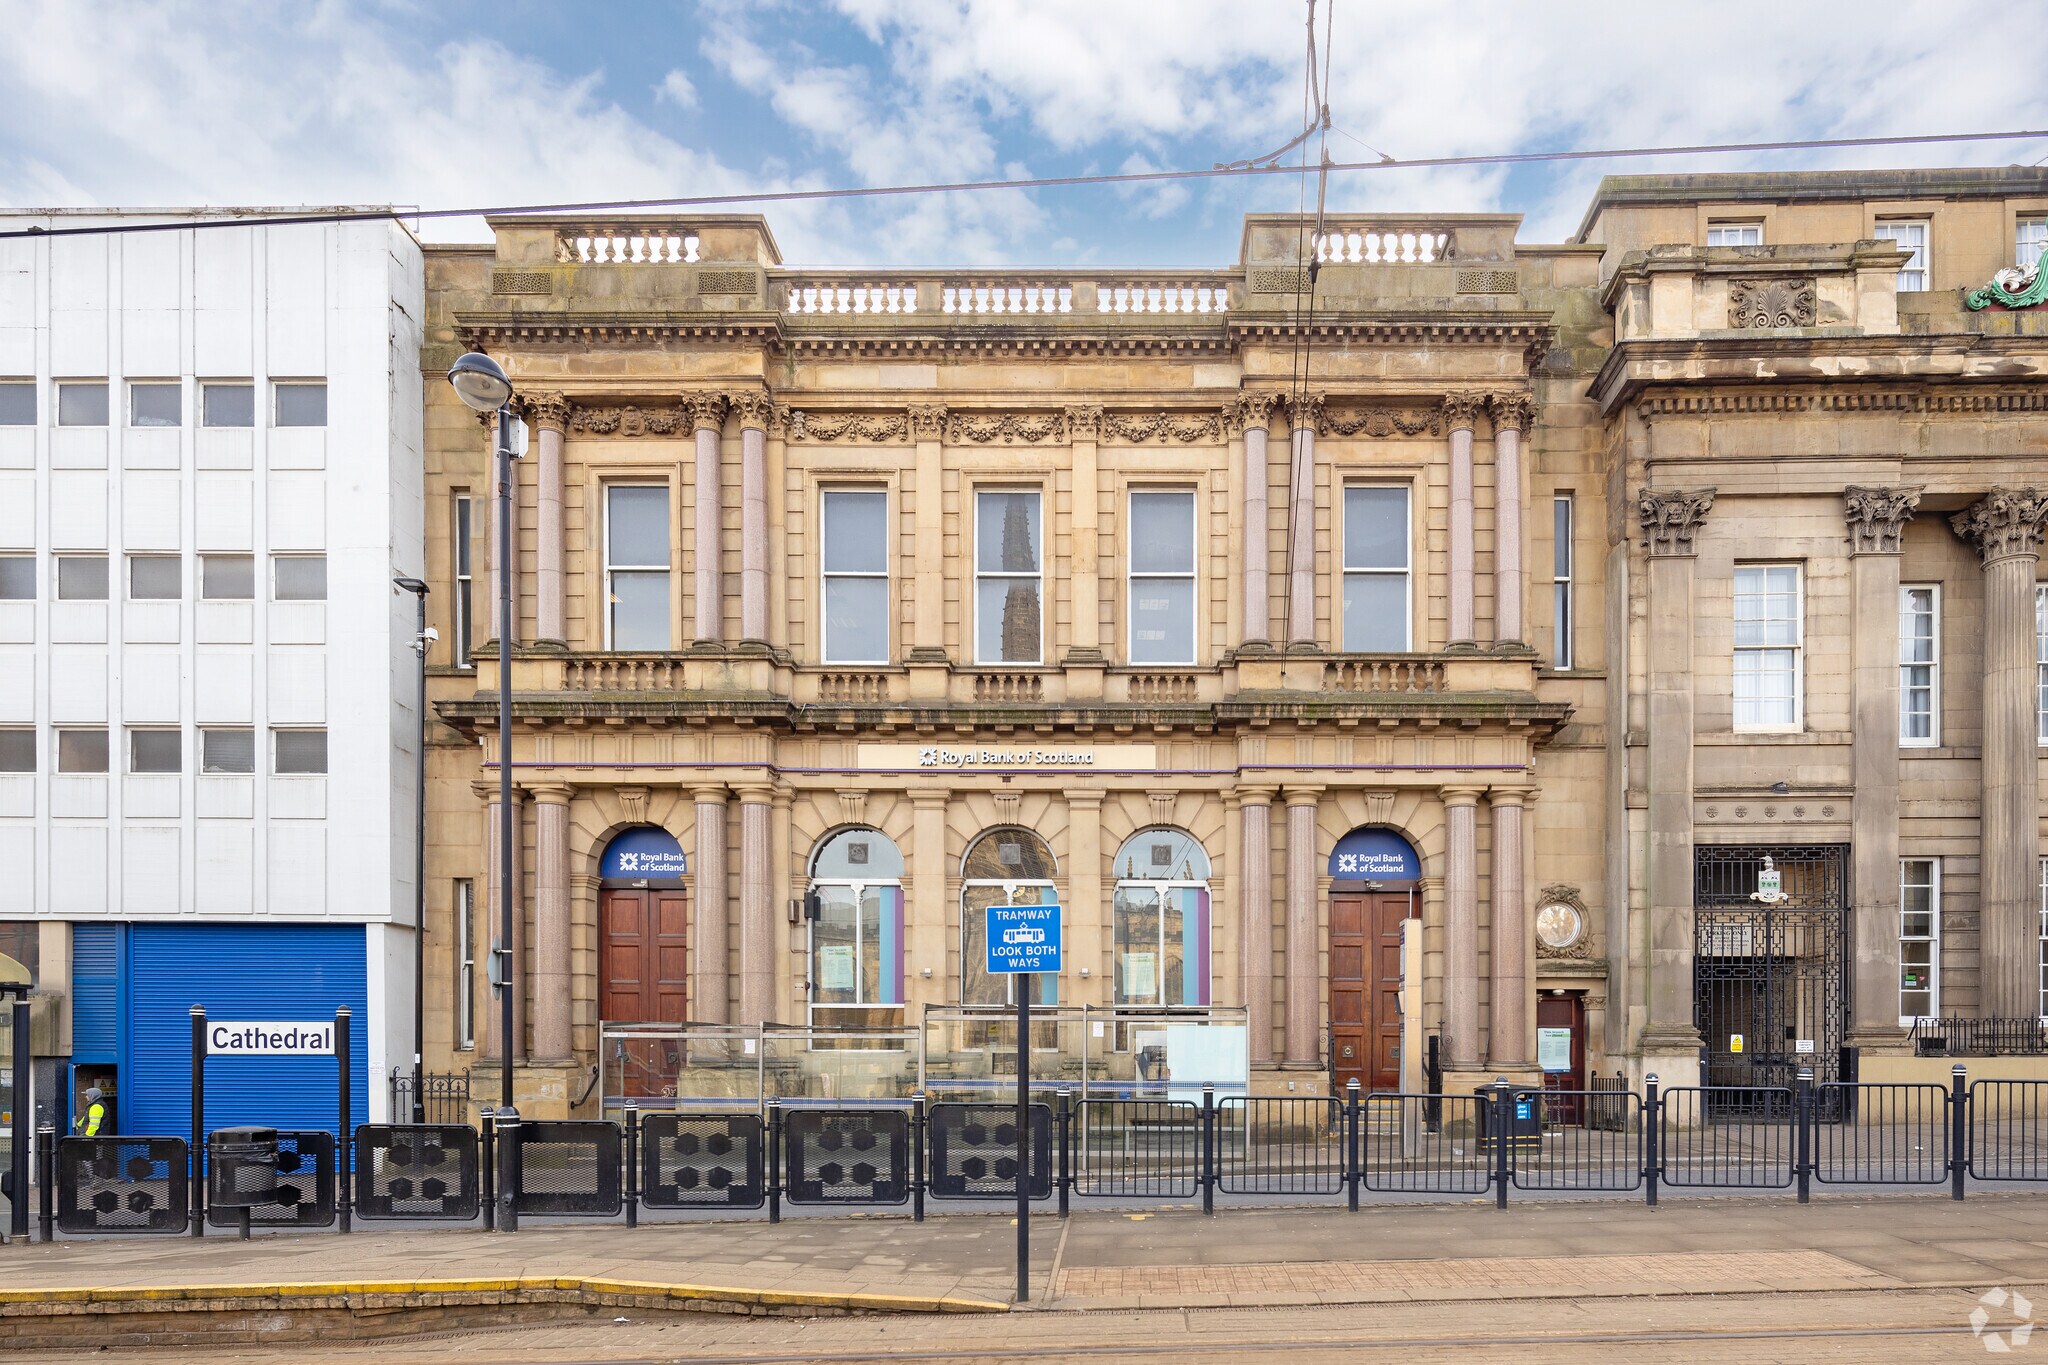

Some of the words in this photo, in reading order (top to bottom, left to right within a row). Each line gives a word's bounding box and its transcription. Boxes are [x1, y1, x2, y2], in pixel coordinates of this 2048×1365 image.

[941, 749, 978, 768] Royal
[981, 749, 1015, 764] Bank
[1016, 749, 1032, 764] of
[1035, 749, 1094, 765] Scotland
[640, 853, 663, 864] Royal
[663, 853, 684, 861] Bank
[1359, 854, 1382, 864] Royal
[1382, 854, 1404, 862] Bank
[640, 863, 650, 871] of
[650, 863, 685, 871] Scotland
[1359, 864, 1369, 872] of
[1369, 864, 1404, 873] Scotland
[996, 910, 1052, 920] TRAMWAY
[992, 946, 1022, 956] LOOK
[1025, 945, 1057, 955] BOTH
[1008, 957, 1040, 968] WAYS
[212, 1027, 330, 1049] Cathedral
